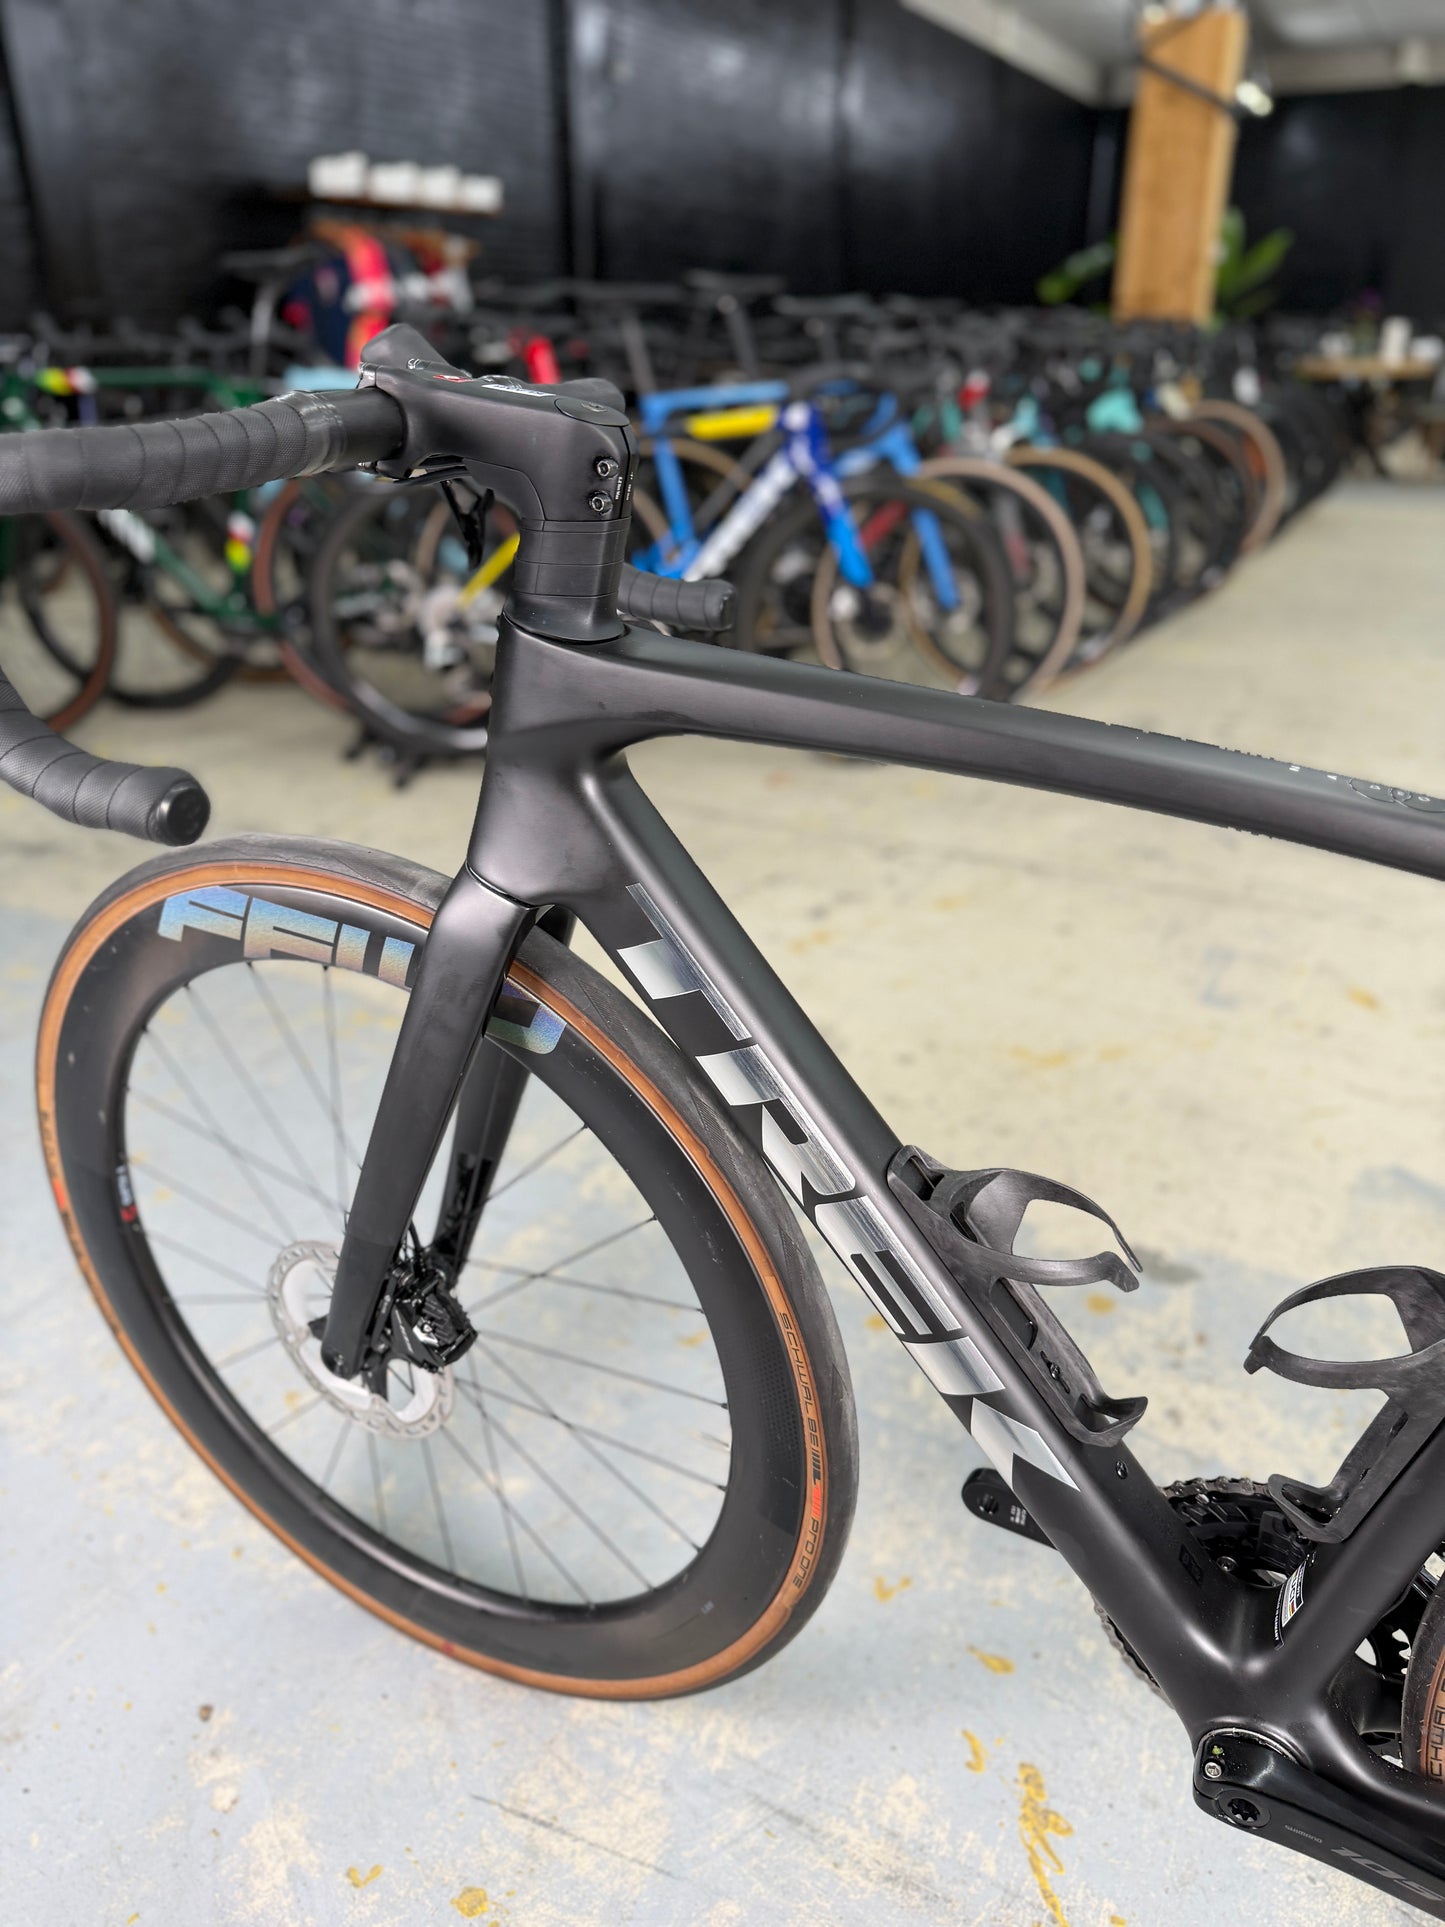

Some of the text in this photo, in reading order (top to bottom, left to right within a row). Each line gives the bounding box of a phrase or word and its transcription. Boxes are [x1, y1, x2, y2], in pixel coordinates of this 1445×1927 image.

[616, 882, 1081, 1493] TREK
[779, 1312, 819, 1447] SCHWALBE
[1330, 1846, 1445, 1902] 105
